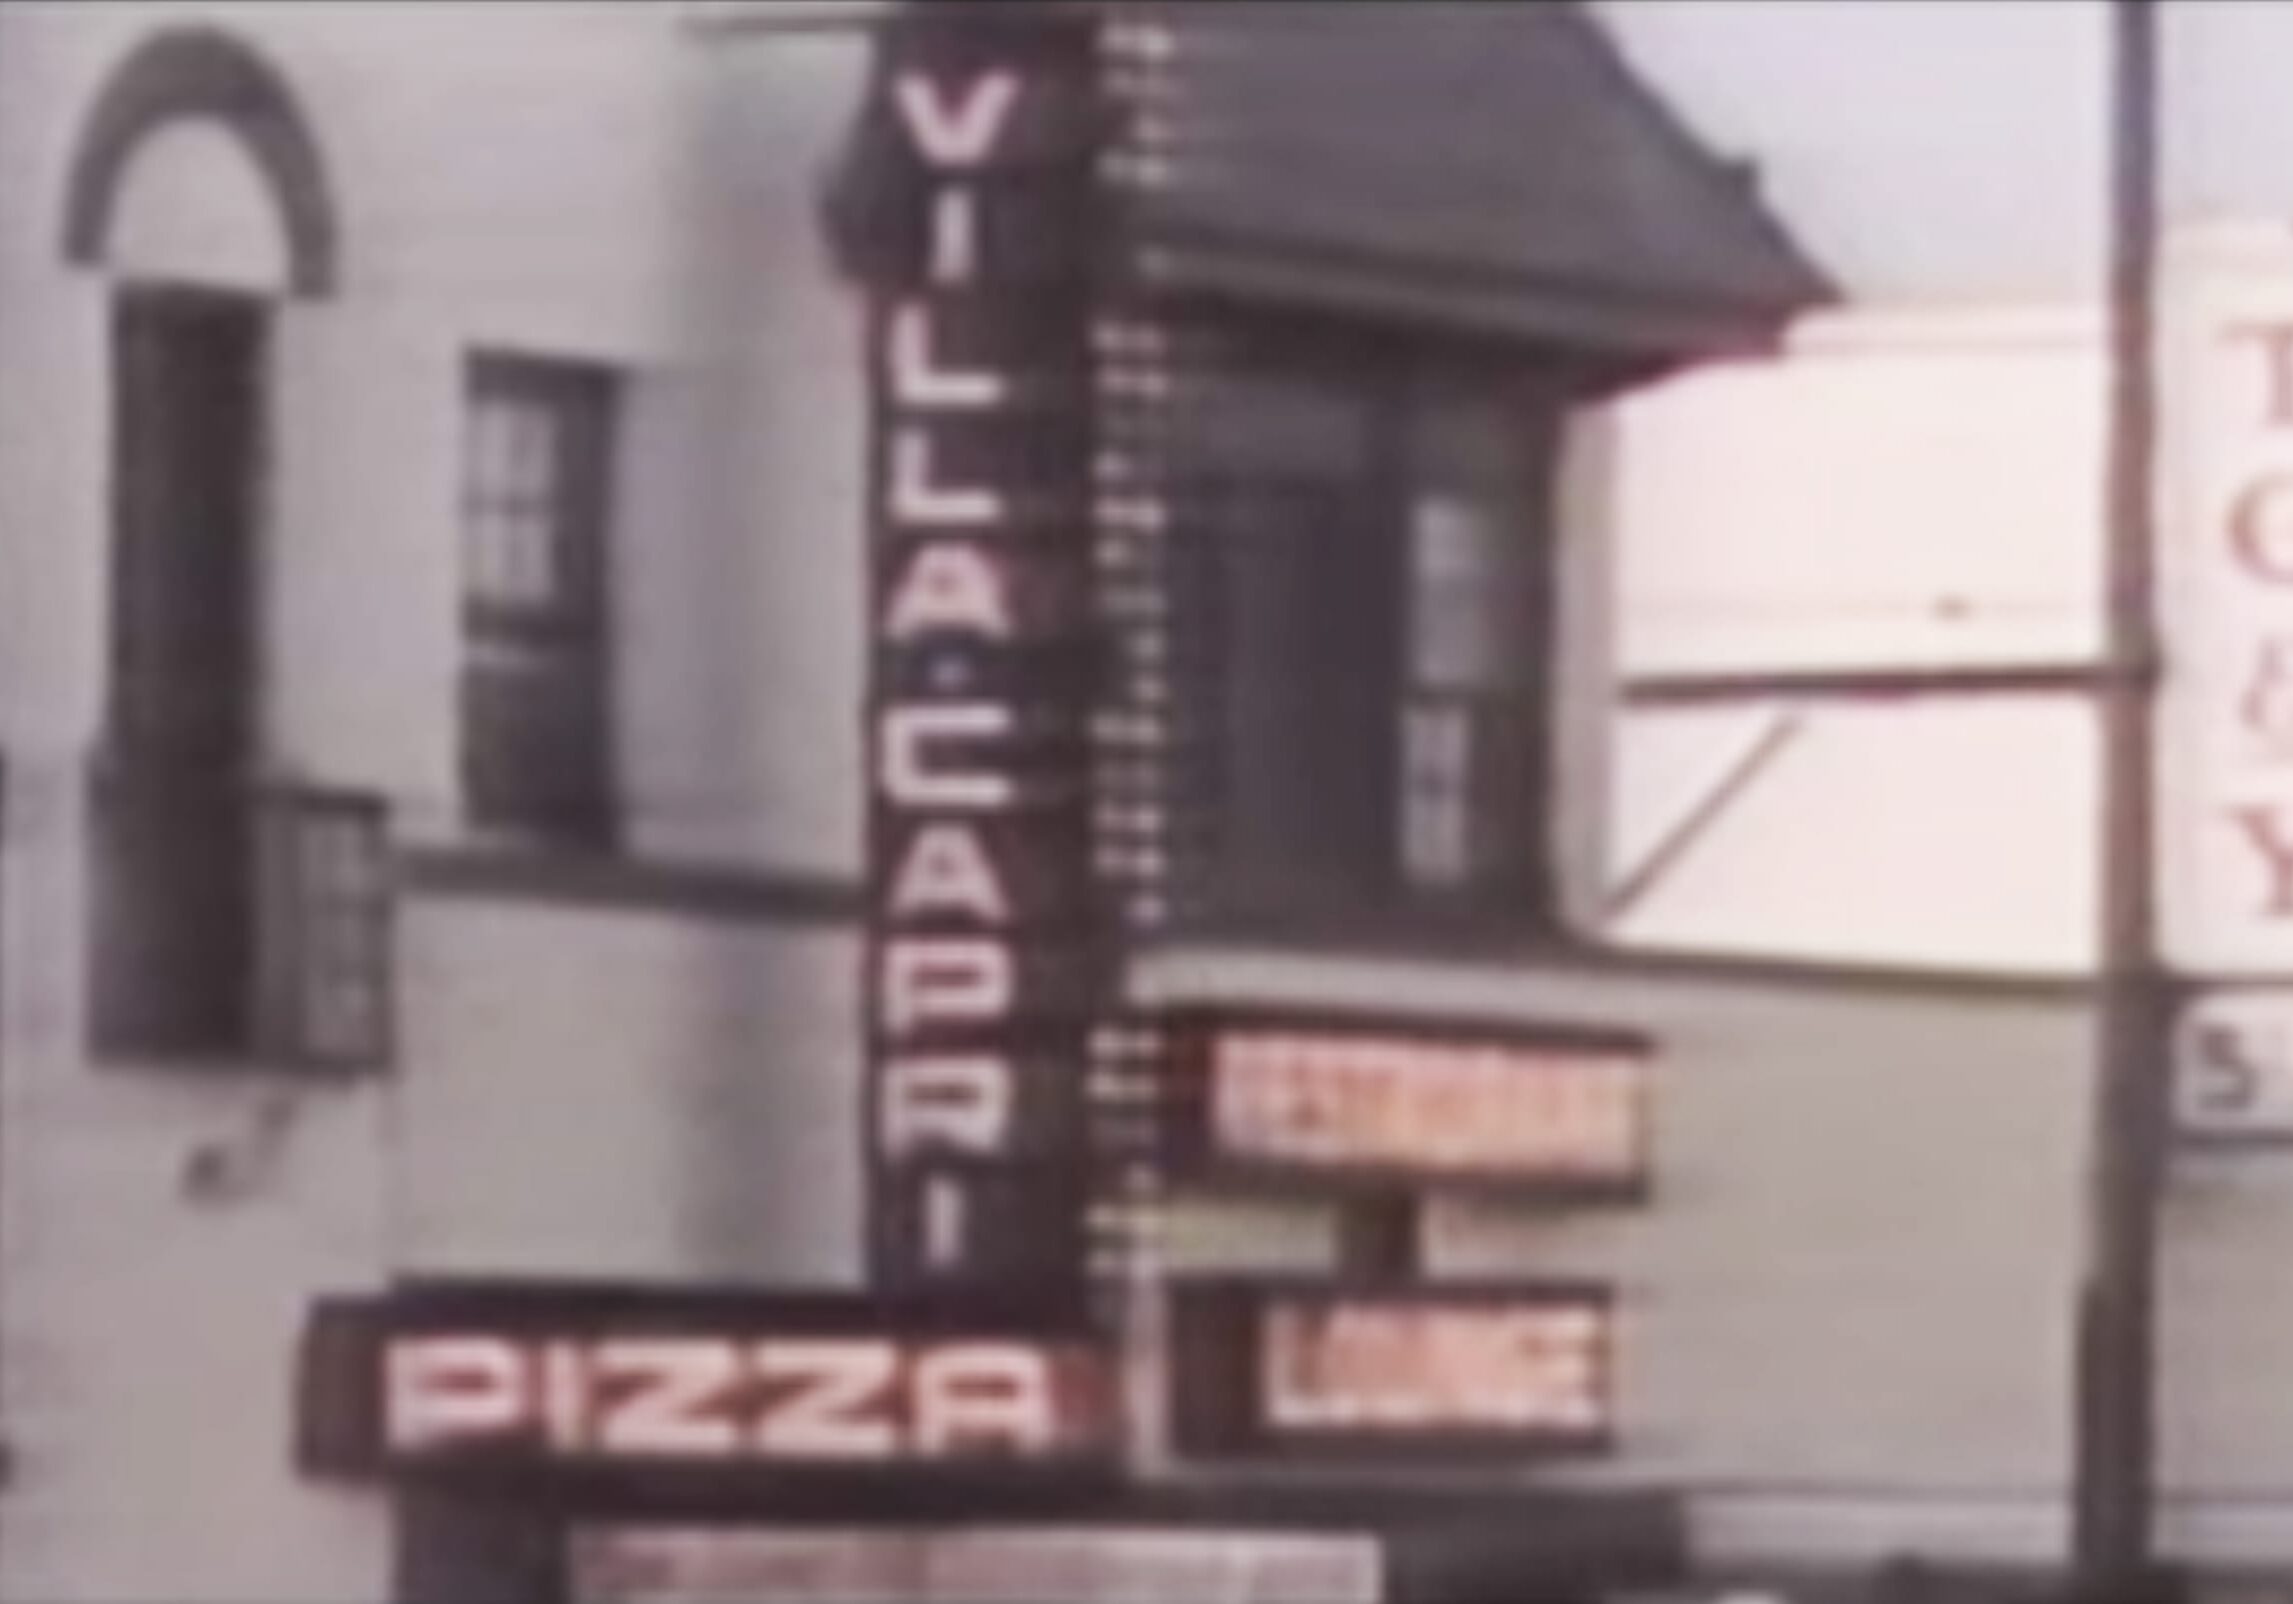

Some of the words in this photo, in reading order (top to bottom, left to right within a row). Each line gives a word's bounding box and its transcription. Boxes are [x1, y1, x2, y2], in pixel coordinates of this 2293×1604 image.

[892, 72, 1018, 638] VILLA
[882, 702, 1012, 1266] CAPRI
[383, 1338, 1056, 1460] PIZZA
